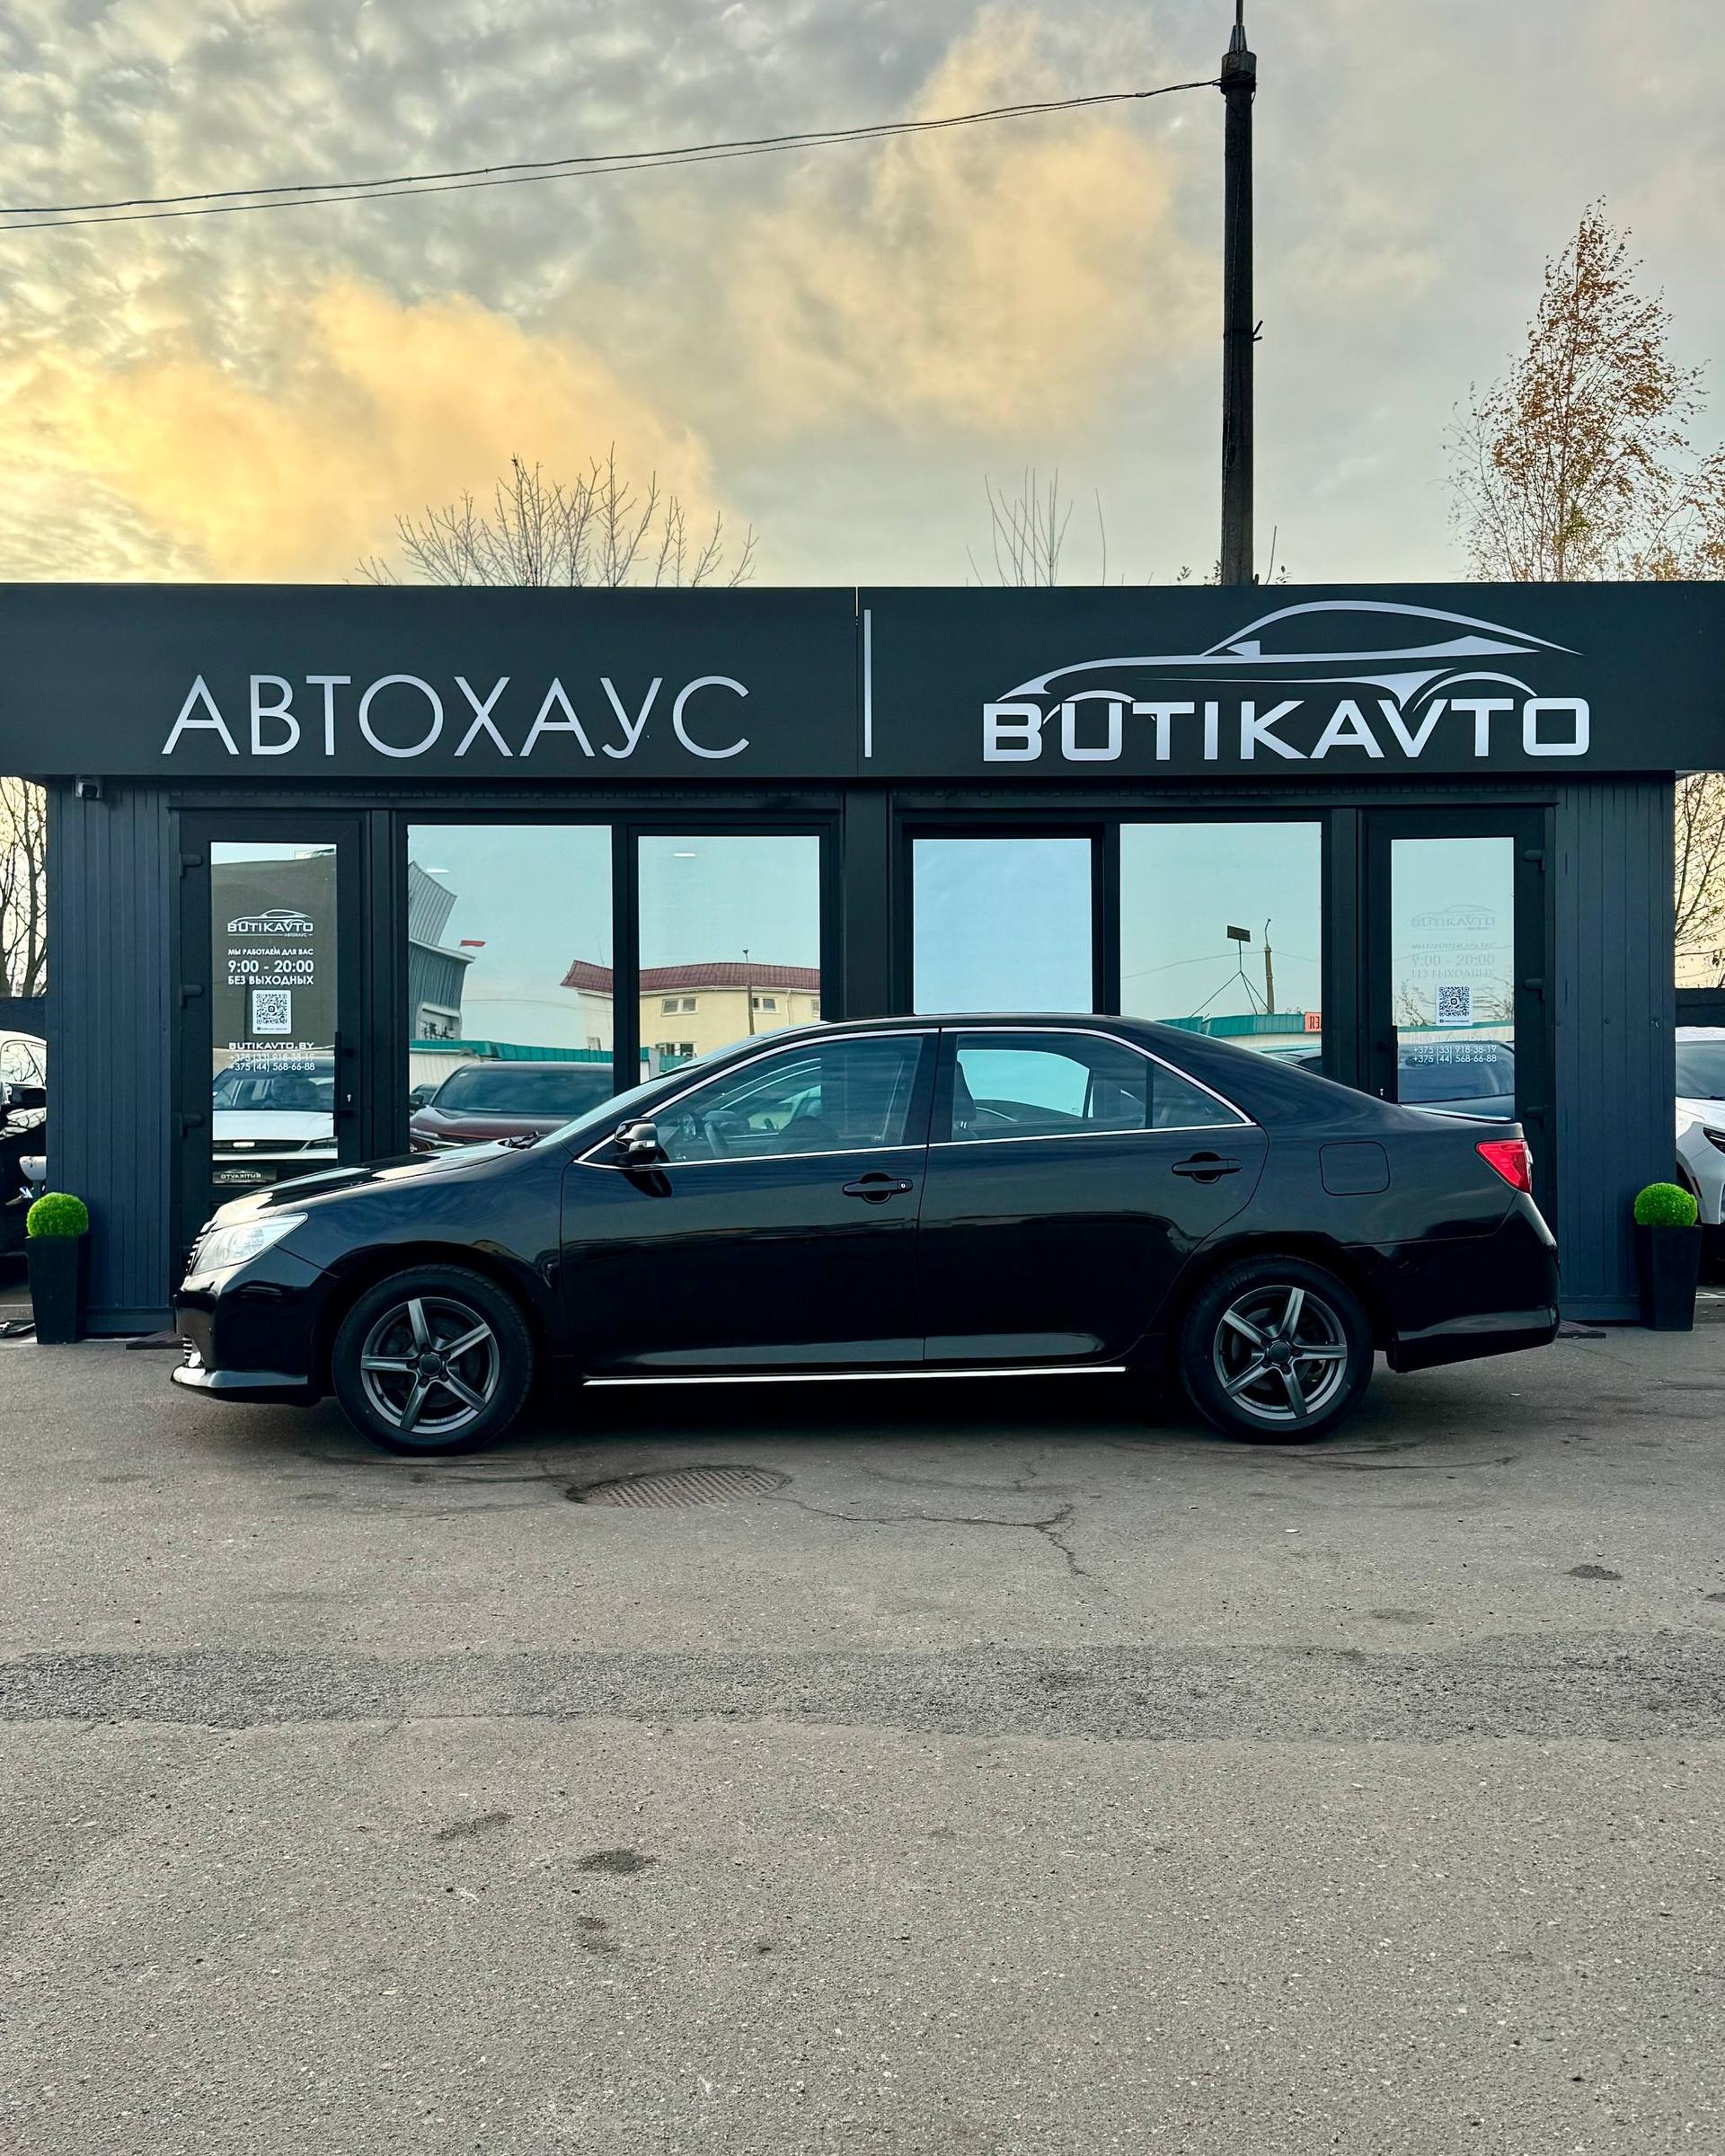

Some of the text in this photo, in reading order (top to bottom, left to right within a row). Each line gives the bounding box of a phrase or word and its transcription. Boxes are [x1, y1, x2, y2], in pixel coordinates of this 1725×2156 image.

[162, 674, 750, 759] АВТОХАУС
[983, 697, 1590, 762] BUTIKAVTO
[227, 922, 314, 932] BUTIKAVTO
[228, 948, 314, 956] МЫ РАБОТАЕМ ДЛЯ ВАС
[1455, 953, 1495, 967] 20:00
[228, 959, 260, 973] 9:00
[273, 959, 314, 973] 20:00
[228, 975, 314, 985] БЕЗ ВЫХОДНЫХ
[228, 1042, 314, 1050] BUTIKAVTO.BY
[1412, 1045, 1498, 1055] +375 (33) 918-38-19
[228, 1053, 315, 1064] +375 (33) 918-38-19
[1412, 1054, 1498, 1065] +375 (44) 568-66-88
[228, 1062, 315, 1073] +375 (44) 568-66-88
